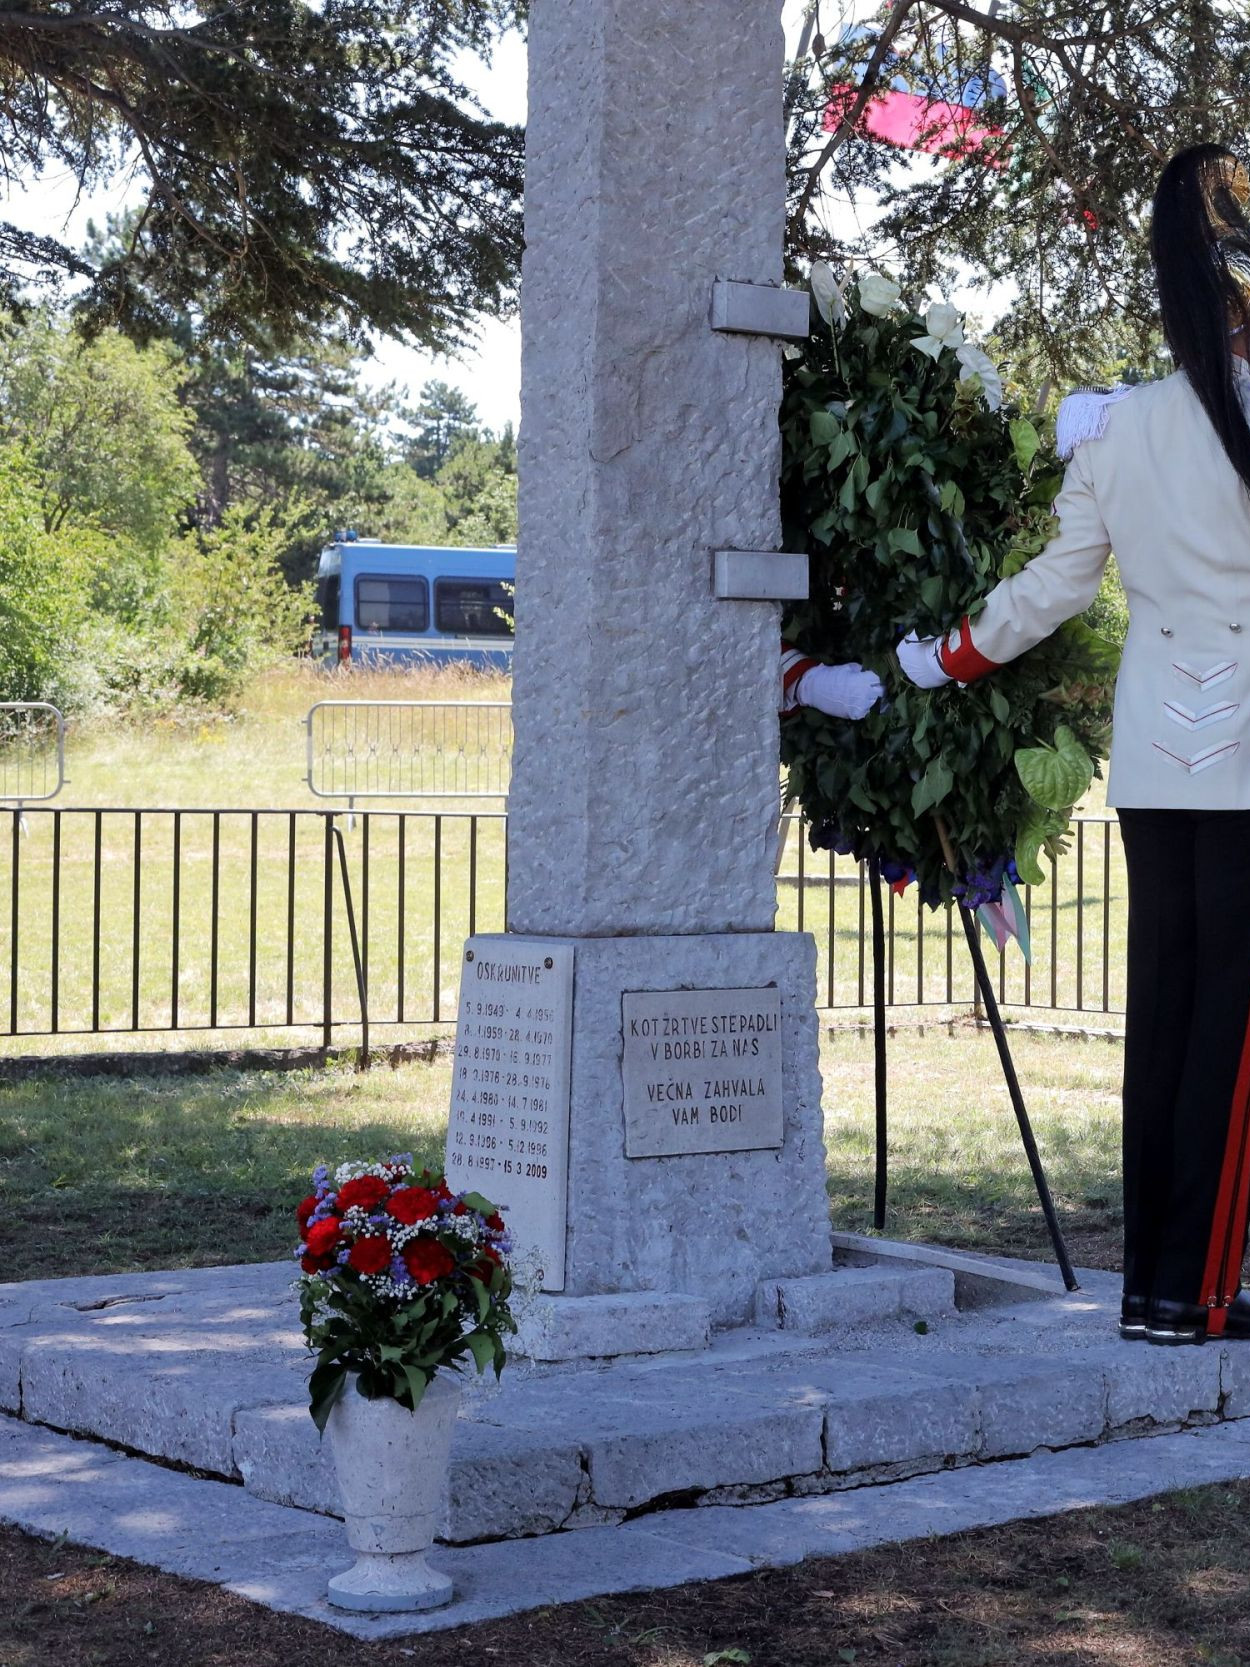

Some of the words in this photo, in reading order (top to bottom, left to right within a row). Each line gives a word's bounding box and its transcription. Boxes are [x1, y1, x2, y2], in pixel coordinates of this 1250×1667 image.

[477, 961, 541, 984] OSKRUNITVE
[630, 1017, 658, 1037] KOT
[712, 1015, 737, 1034] STE
[740, 1013, 777, 1032] PADLI
[651, 1043, 658, 1060] V
[664, 1040, 706, 1060] BORBI
[711, 1040, 728, 1058] ZA
[733, 1038, 760, 1057] NAS
[647, 1076, 693, 1102] VEČNA
[704, 1078, 764, 1099] ZAHVALA
[672, 1106, 700, 1127] VAM
[710, 1104, 740, 1123] BODI
